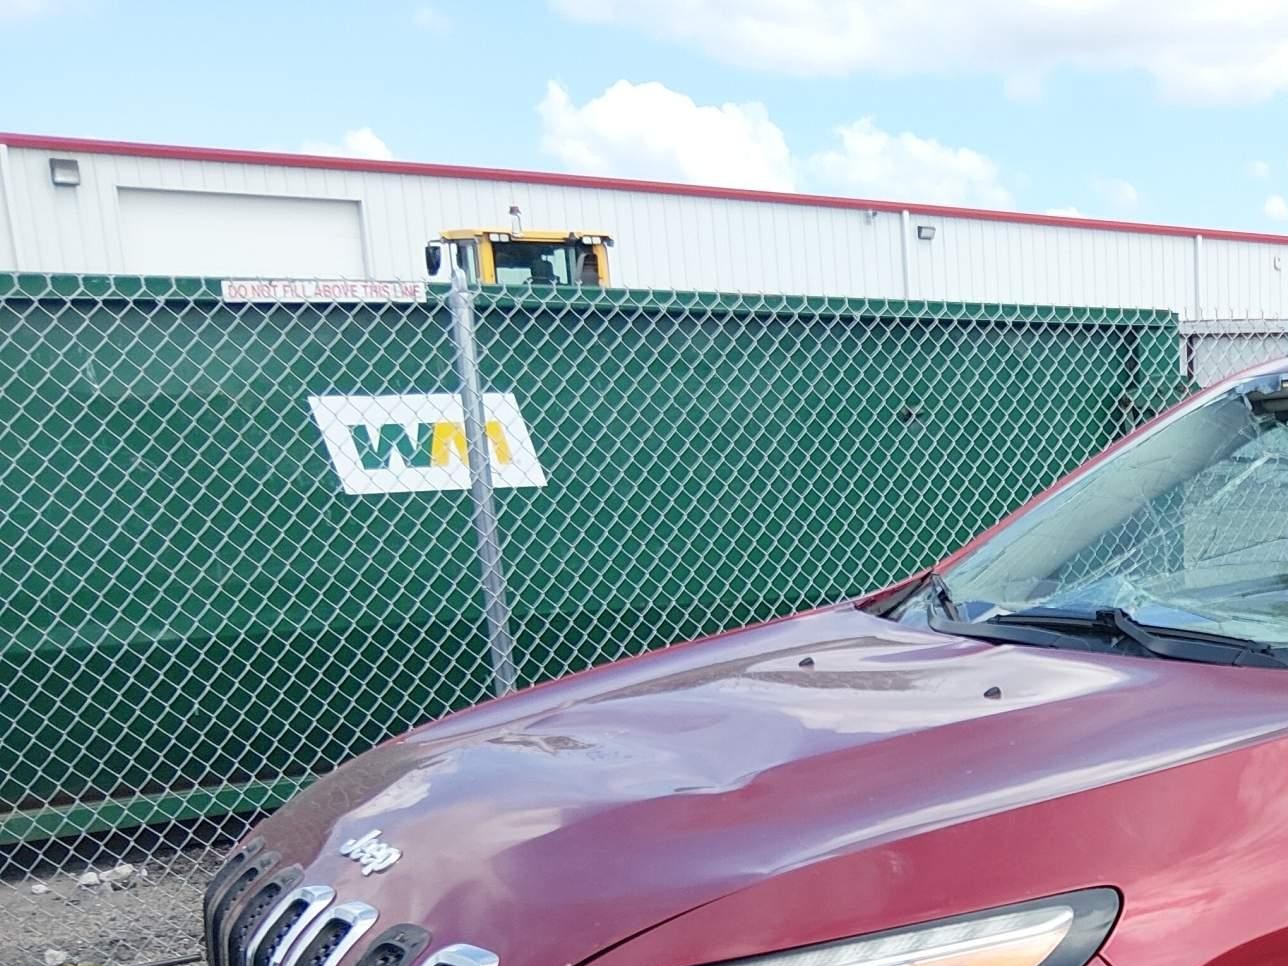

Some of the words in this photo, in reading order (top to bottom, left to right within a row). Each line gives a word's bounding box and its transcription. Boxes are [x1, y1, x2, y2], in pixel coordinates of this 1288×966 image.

[228, 284, 248, 298] DO
[251, 284, 278, 299] NOT
[282, 284, 311, 299] FILL
[314, 284, 359, 299] ABOVE
[361, 285, 391, 299] THIS
[394, 285, 420, 300] LINE
[346, 421, 512, 470] WM
[339, 828, 402, 876] Jeep
